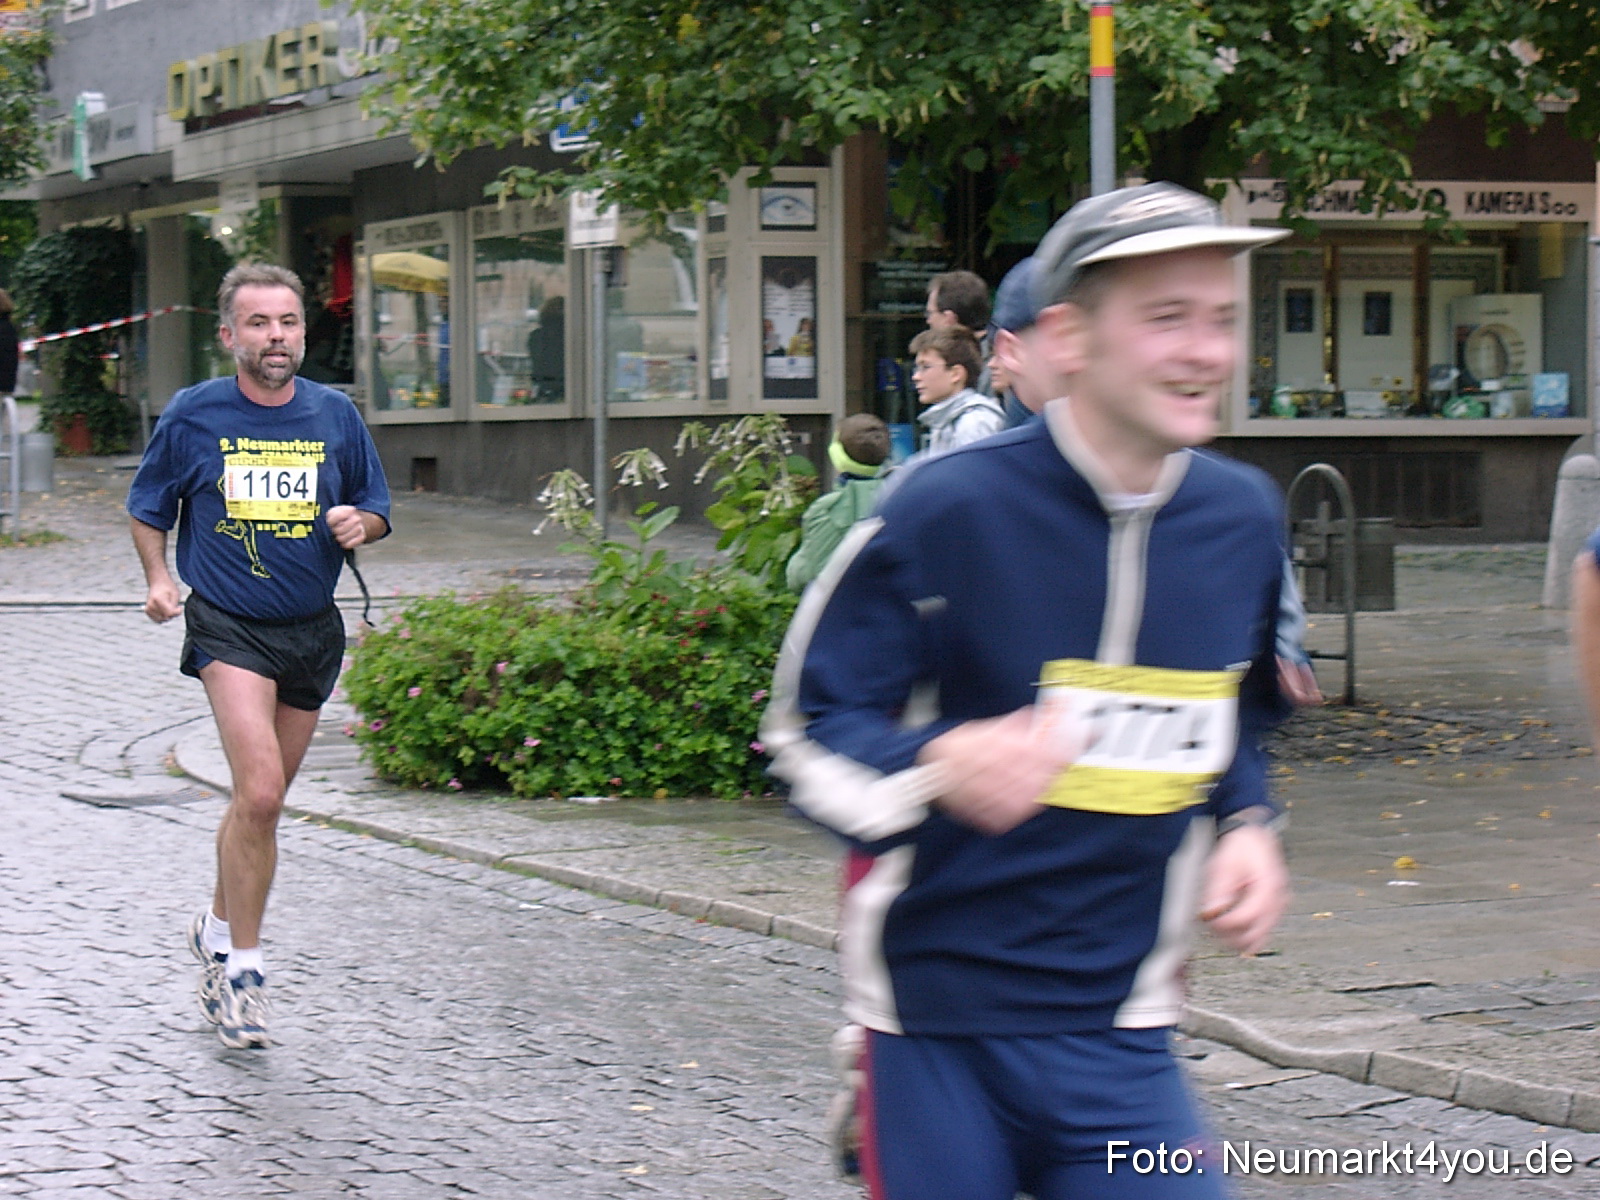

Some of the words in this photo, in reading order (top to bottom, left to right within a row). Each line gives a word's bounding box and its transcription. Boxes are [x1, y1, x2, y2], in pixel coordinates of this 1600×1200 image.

[168, 20, 331, 121] OPTIKER
[238, 438, 325, 452] Neumarkter
[243, 470, 309, 499] 1164
